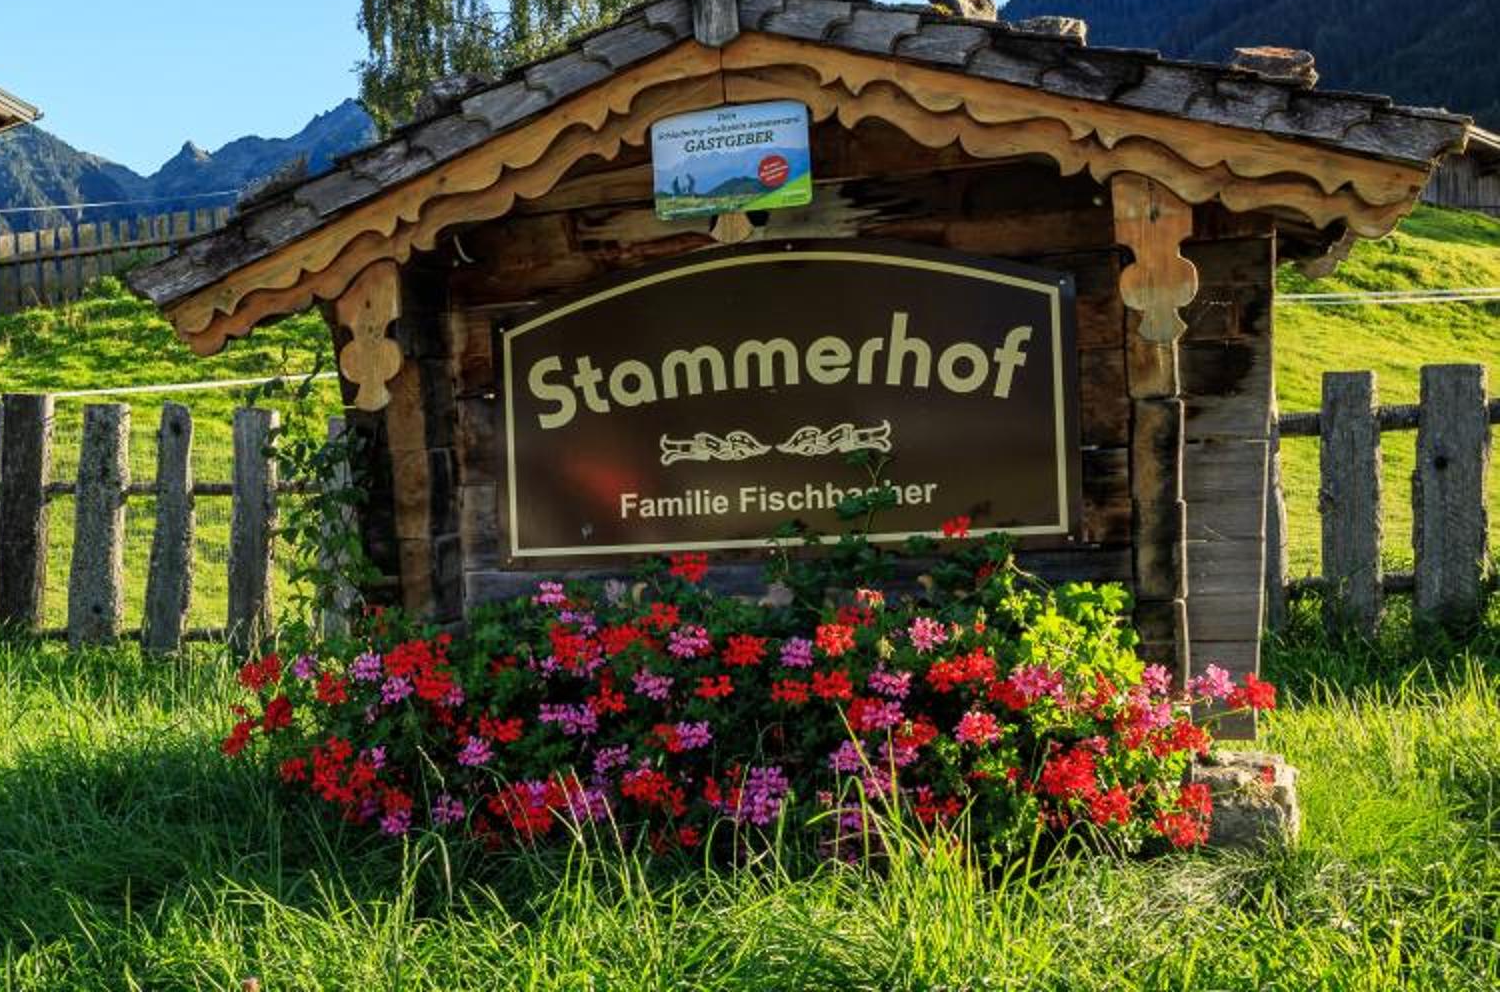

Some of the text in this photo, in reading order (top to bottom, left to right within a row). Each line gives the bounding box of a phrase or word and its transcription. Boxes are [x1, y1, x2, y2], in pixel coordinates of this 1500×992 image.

[684, 130, 774, 153] GASTGEBER
[528, 312, 1033, 429] Stammerhof
[620, 489, 729, 519] Familie
